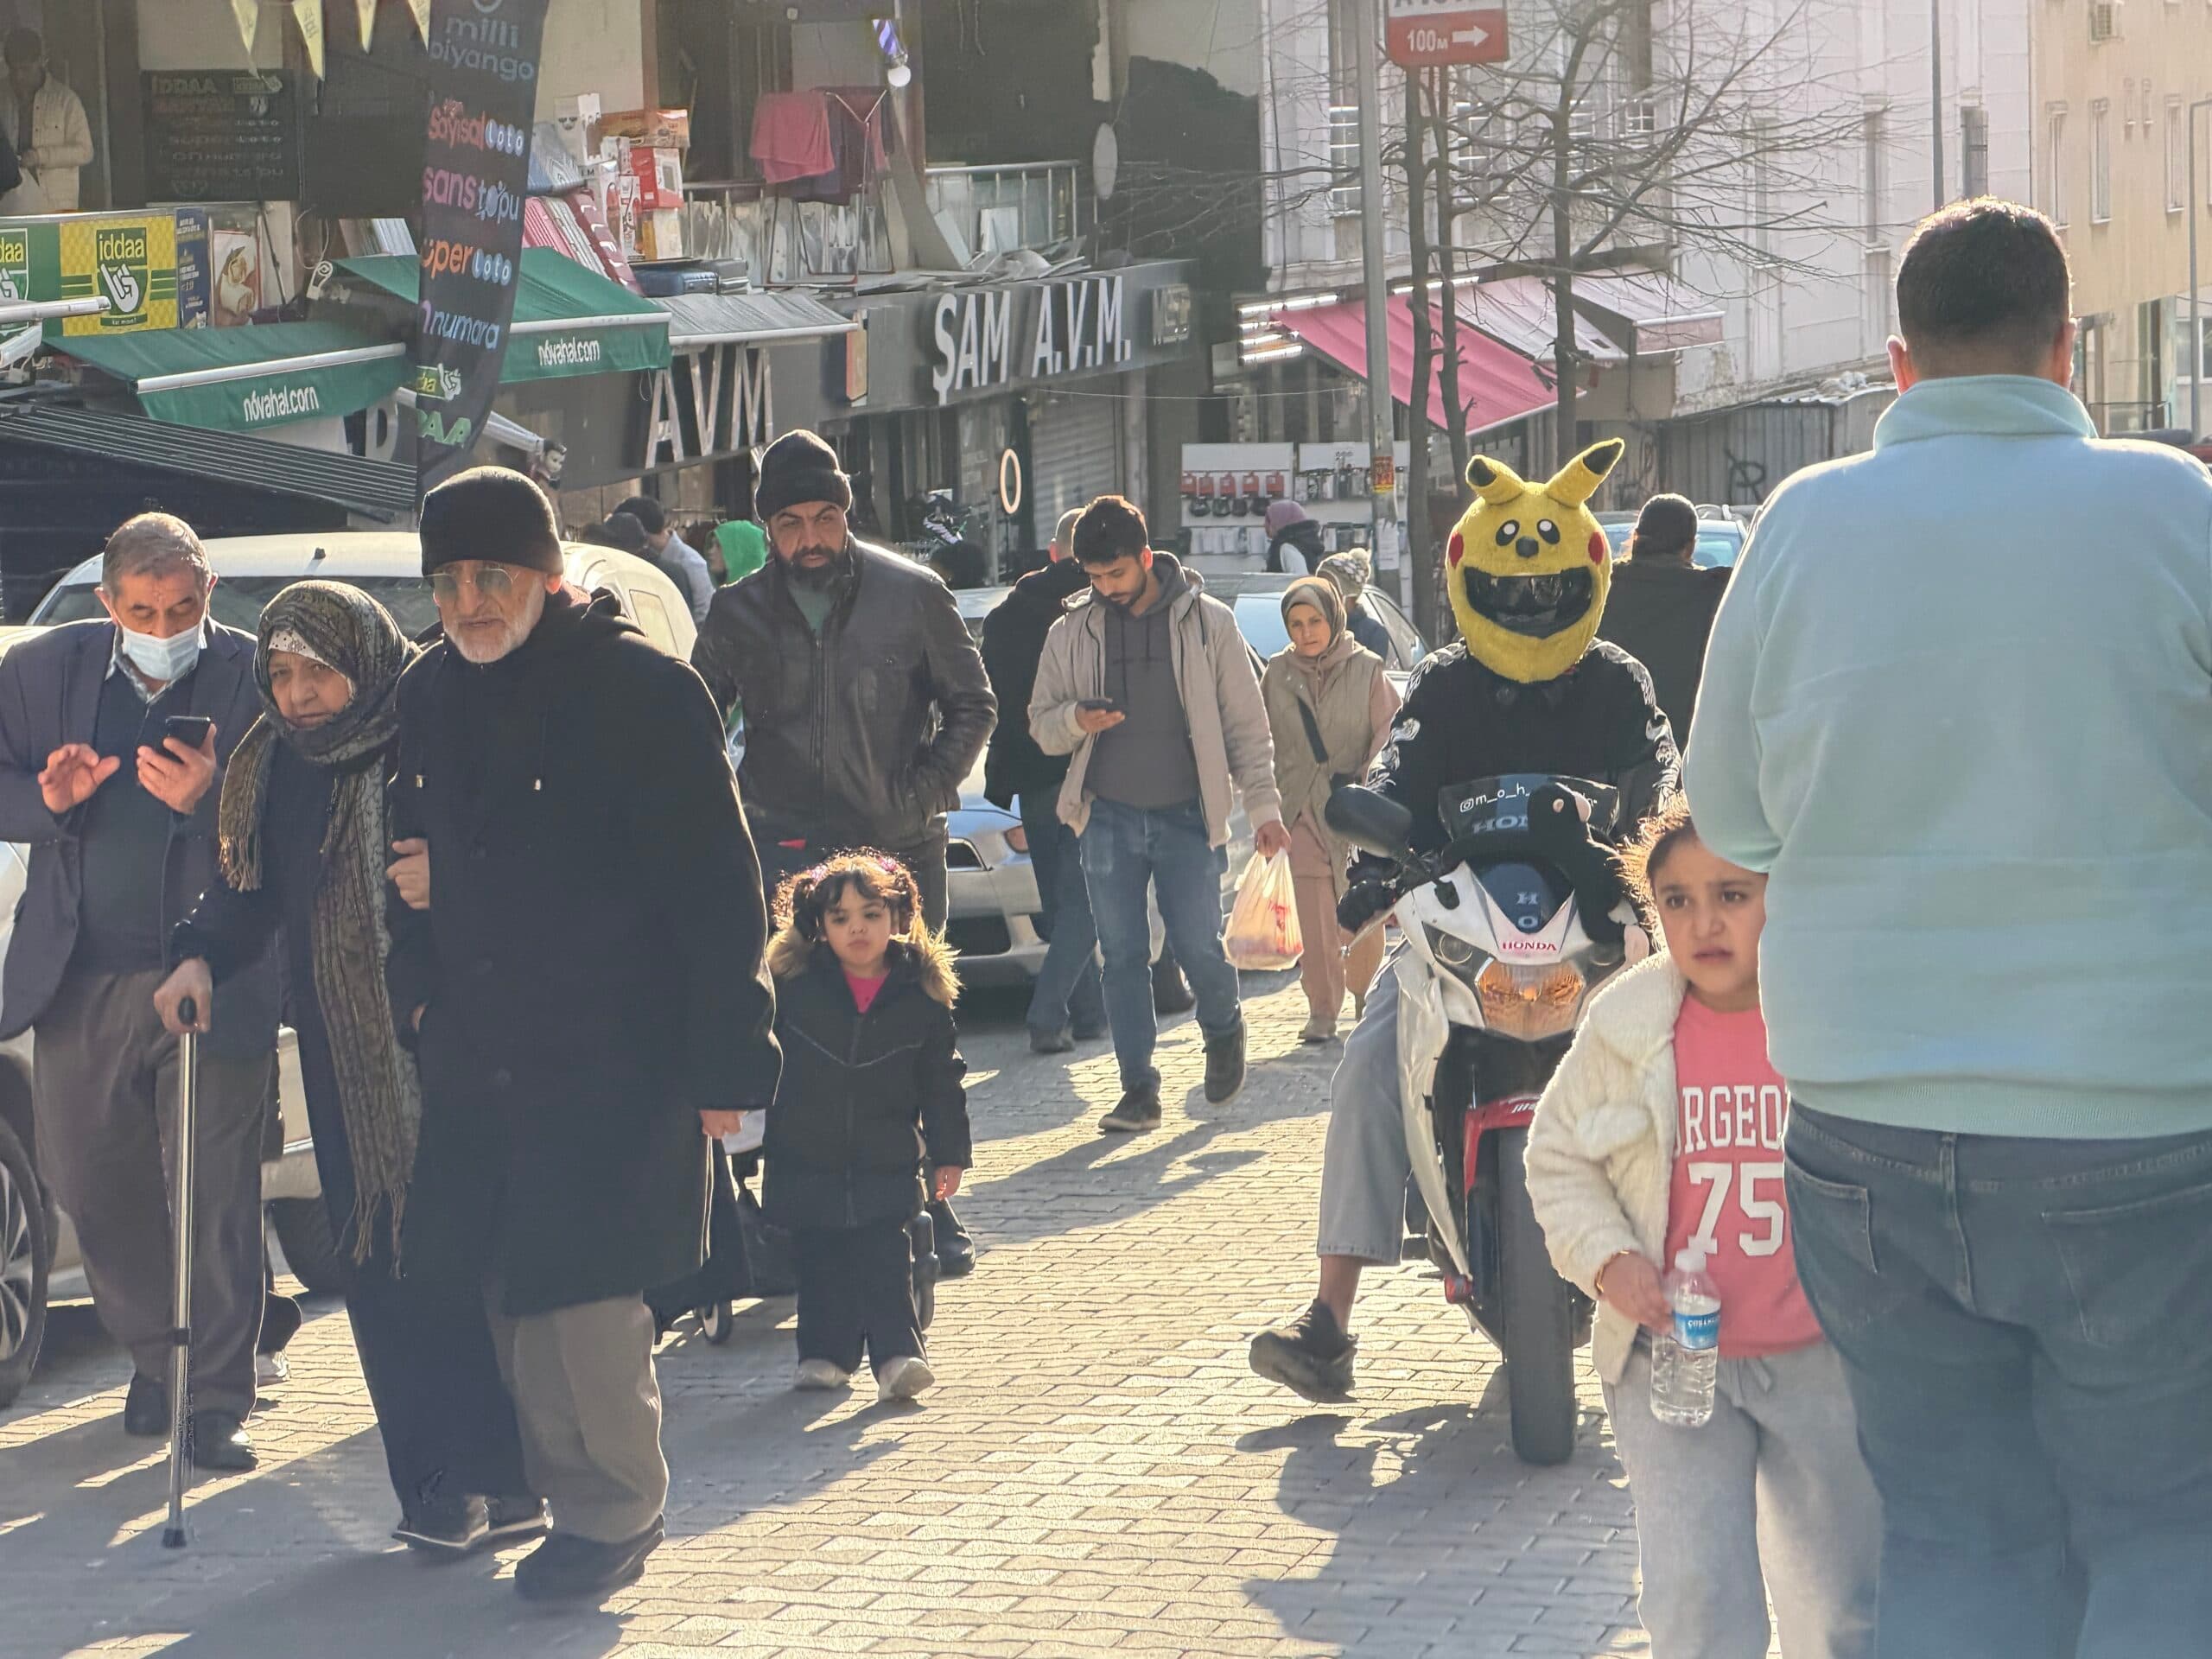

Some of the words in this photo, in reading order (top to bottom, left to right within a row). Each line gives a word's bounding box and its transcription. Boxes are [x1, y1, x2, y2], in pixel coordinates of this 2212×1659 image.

[99, 232, 145, 260] iddaa
[1031, 276, 1131, 378] A.V.M.
[1503, 941, 1557, 951] HONDA
[1688, 1161, 1785, 1256] 75
